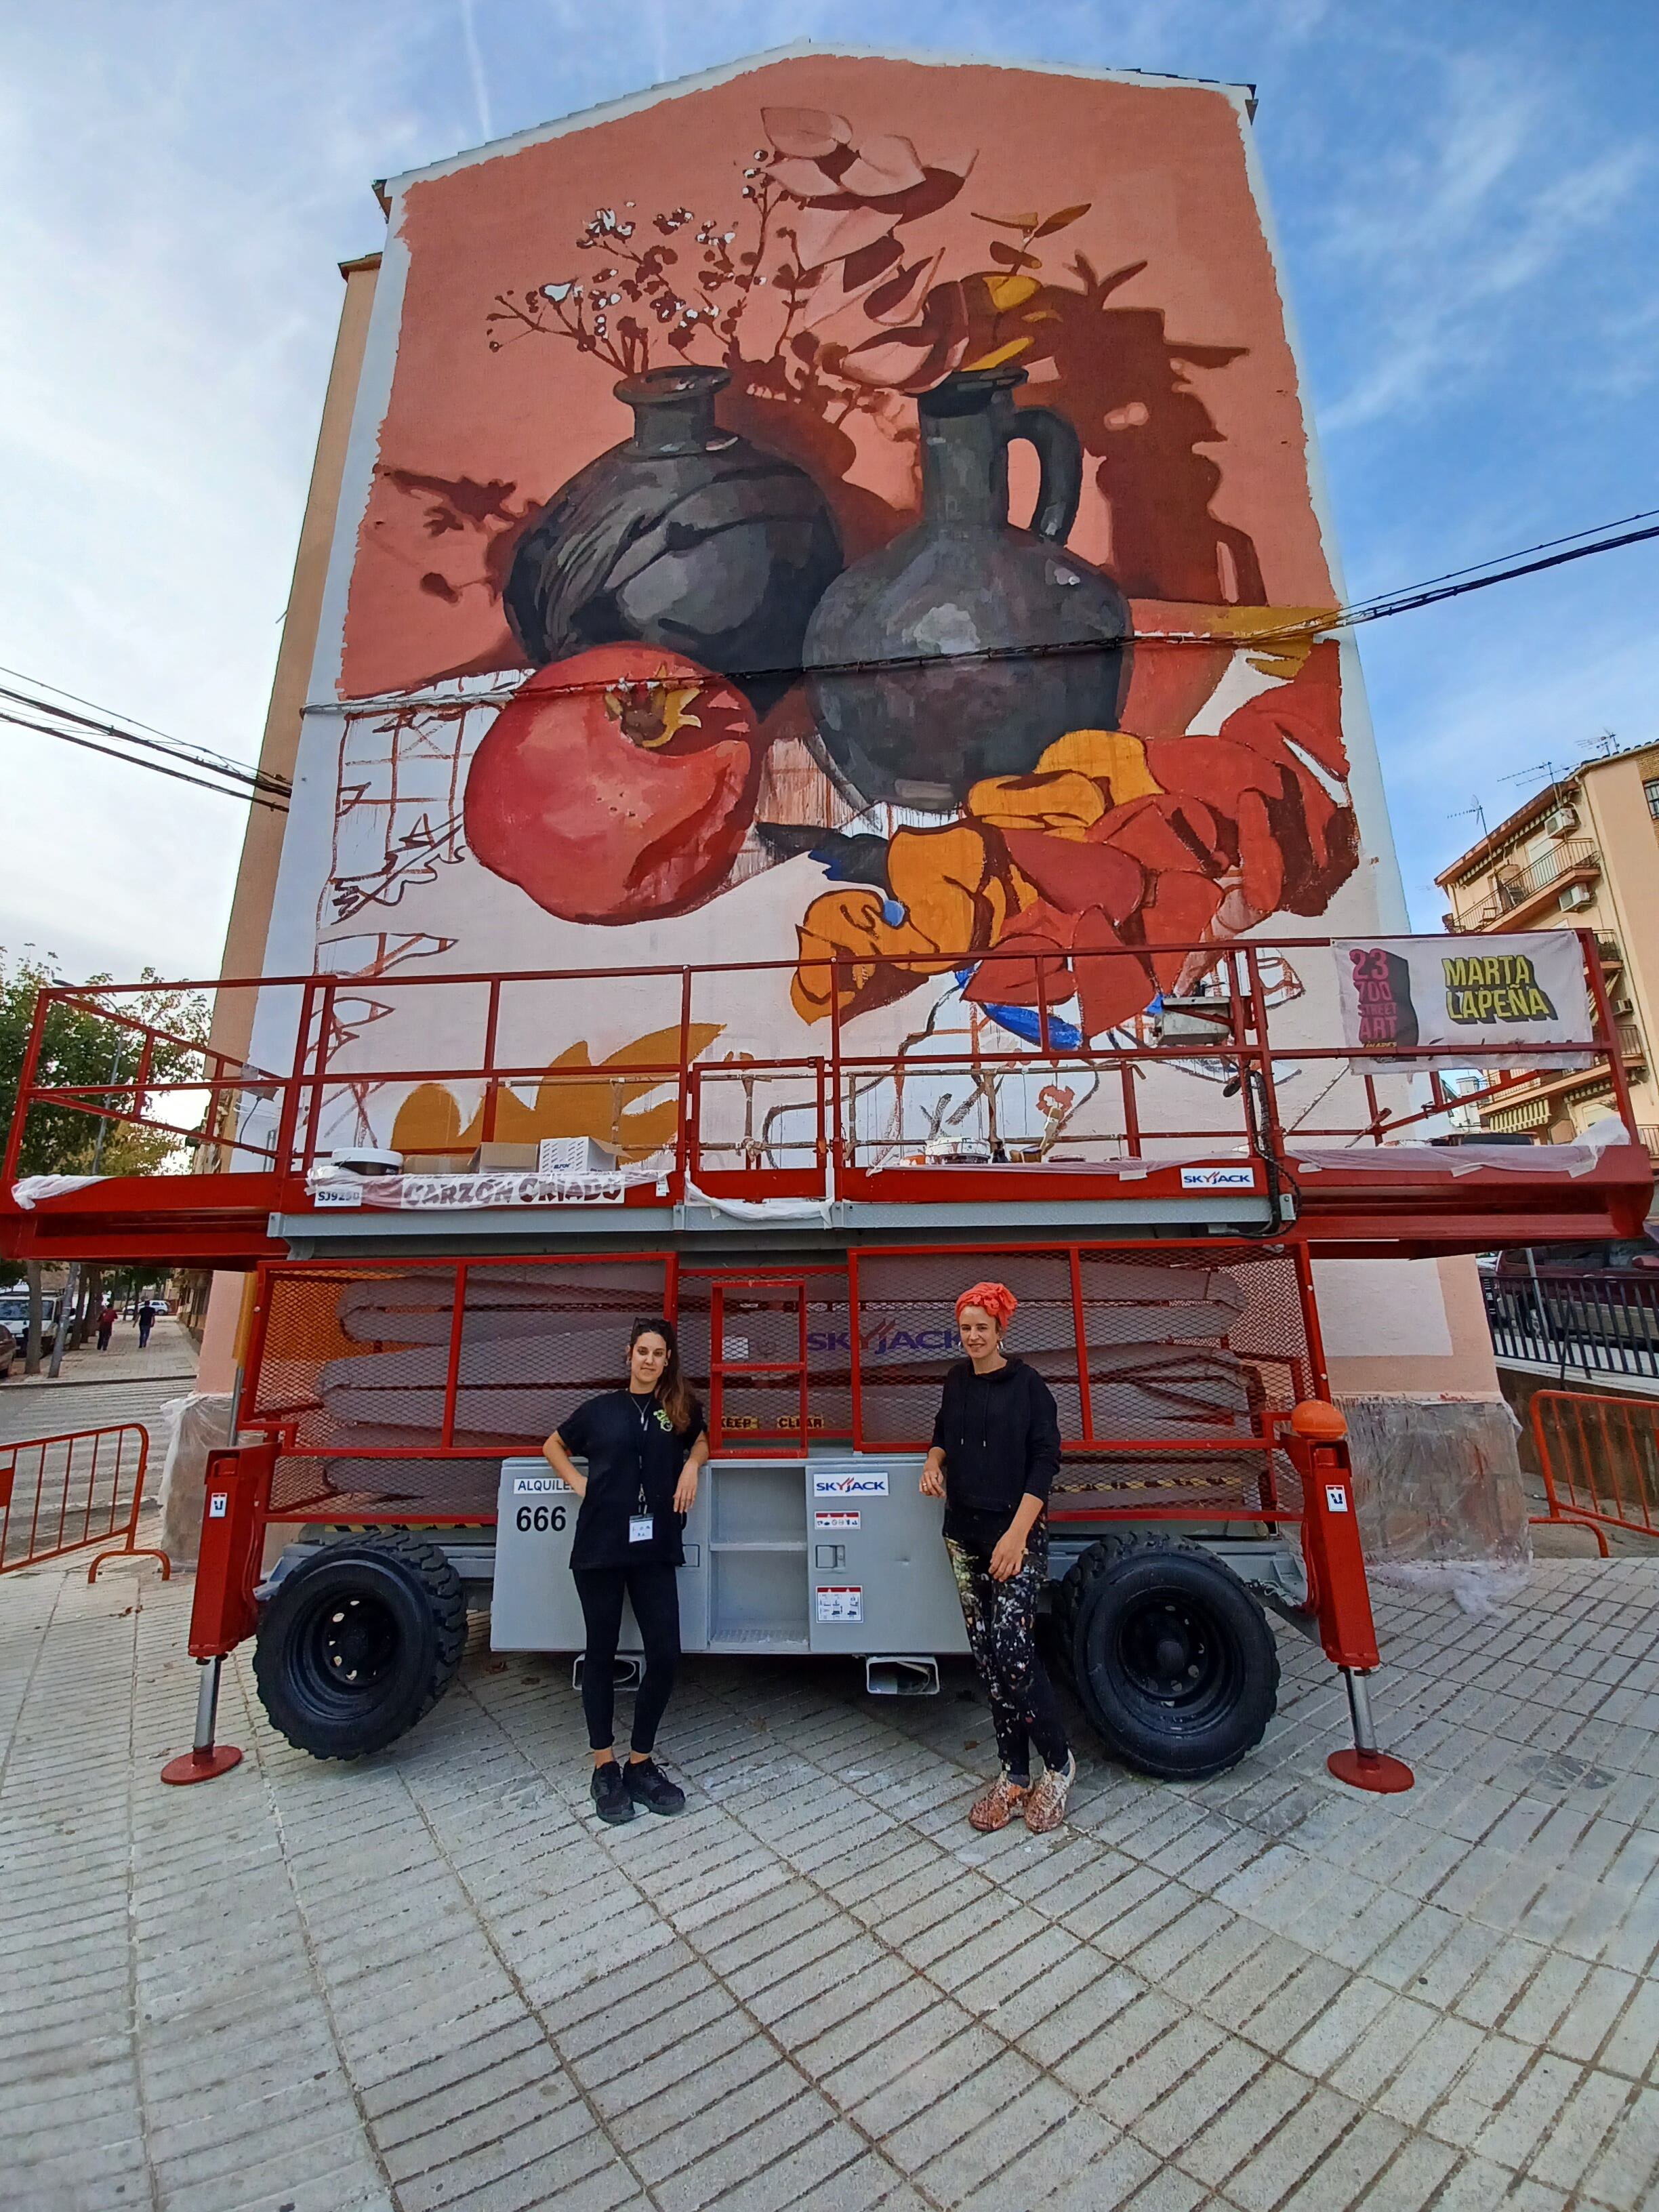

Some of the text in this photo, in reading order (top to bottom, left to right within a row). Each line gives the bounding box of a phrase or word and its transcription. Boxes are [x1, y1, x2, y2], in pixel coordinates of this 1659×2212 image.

[1349, 948, 1389, 980] 23
[1442, 955, 1531, 986] MARTA
[1354, 981, 1393, 1002] 700
[1446, 985, 1550, 1019] LAPEÑA
[1358, 1002, 1397, 1017] STREET
[1359, 1017, 1397, 1040] ART
[1183, 1171, 1251, 1185] SKYJACK
[807, 1319, 960, 1355] SKYJACK
[518, 1480, 575, 1491] ALQUILE
[816, 1477, 885, 1493] SKYJACK
[516, 1505, 567, 1532] 666
